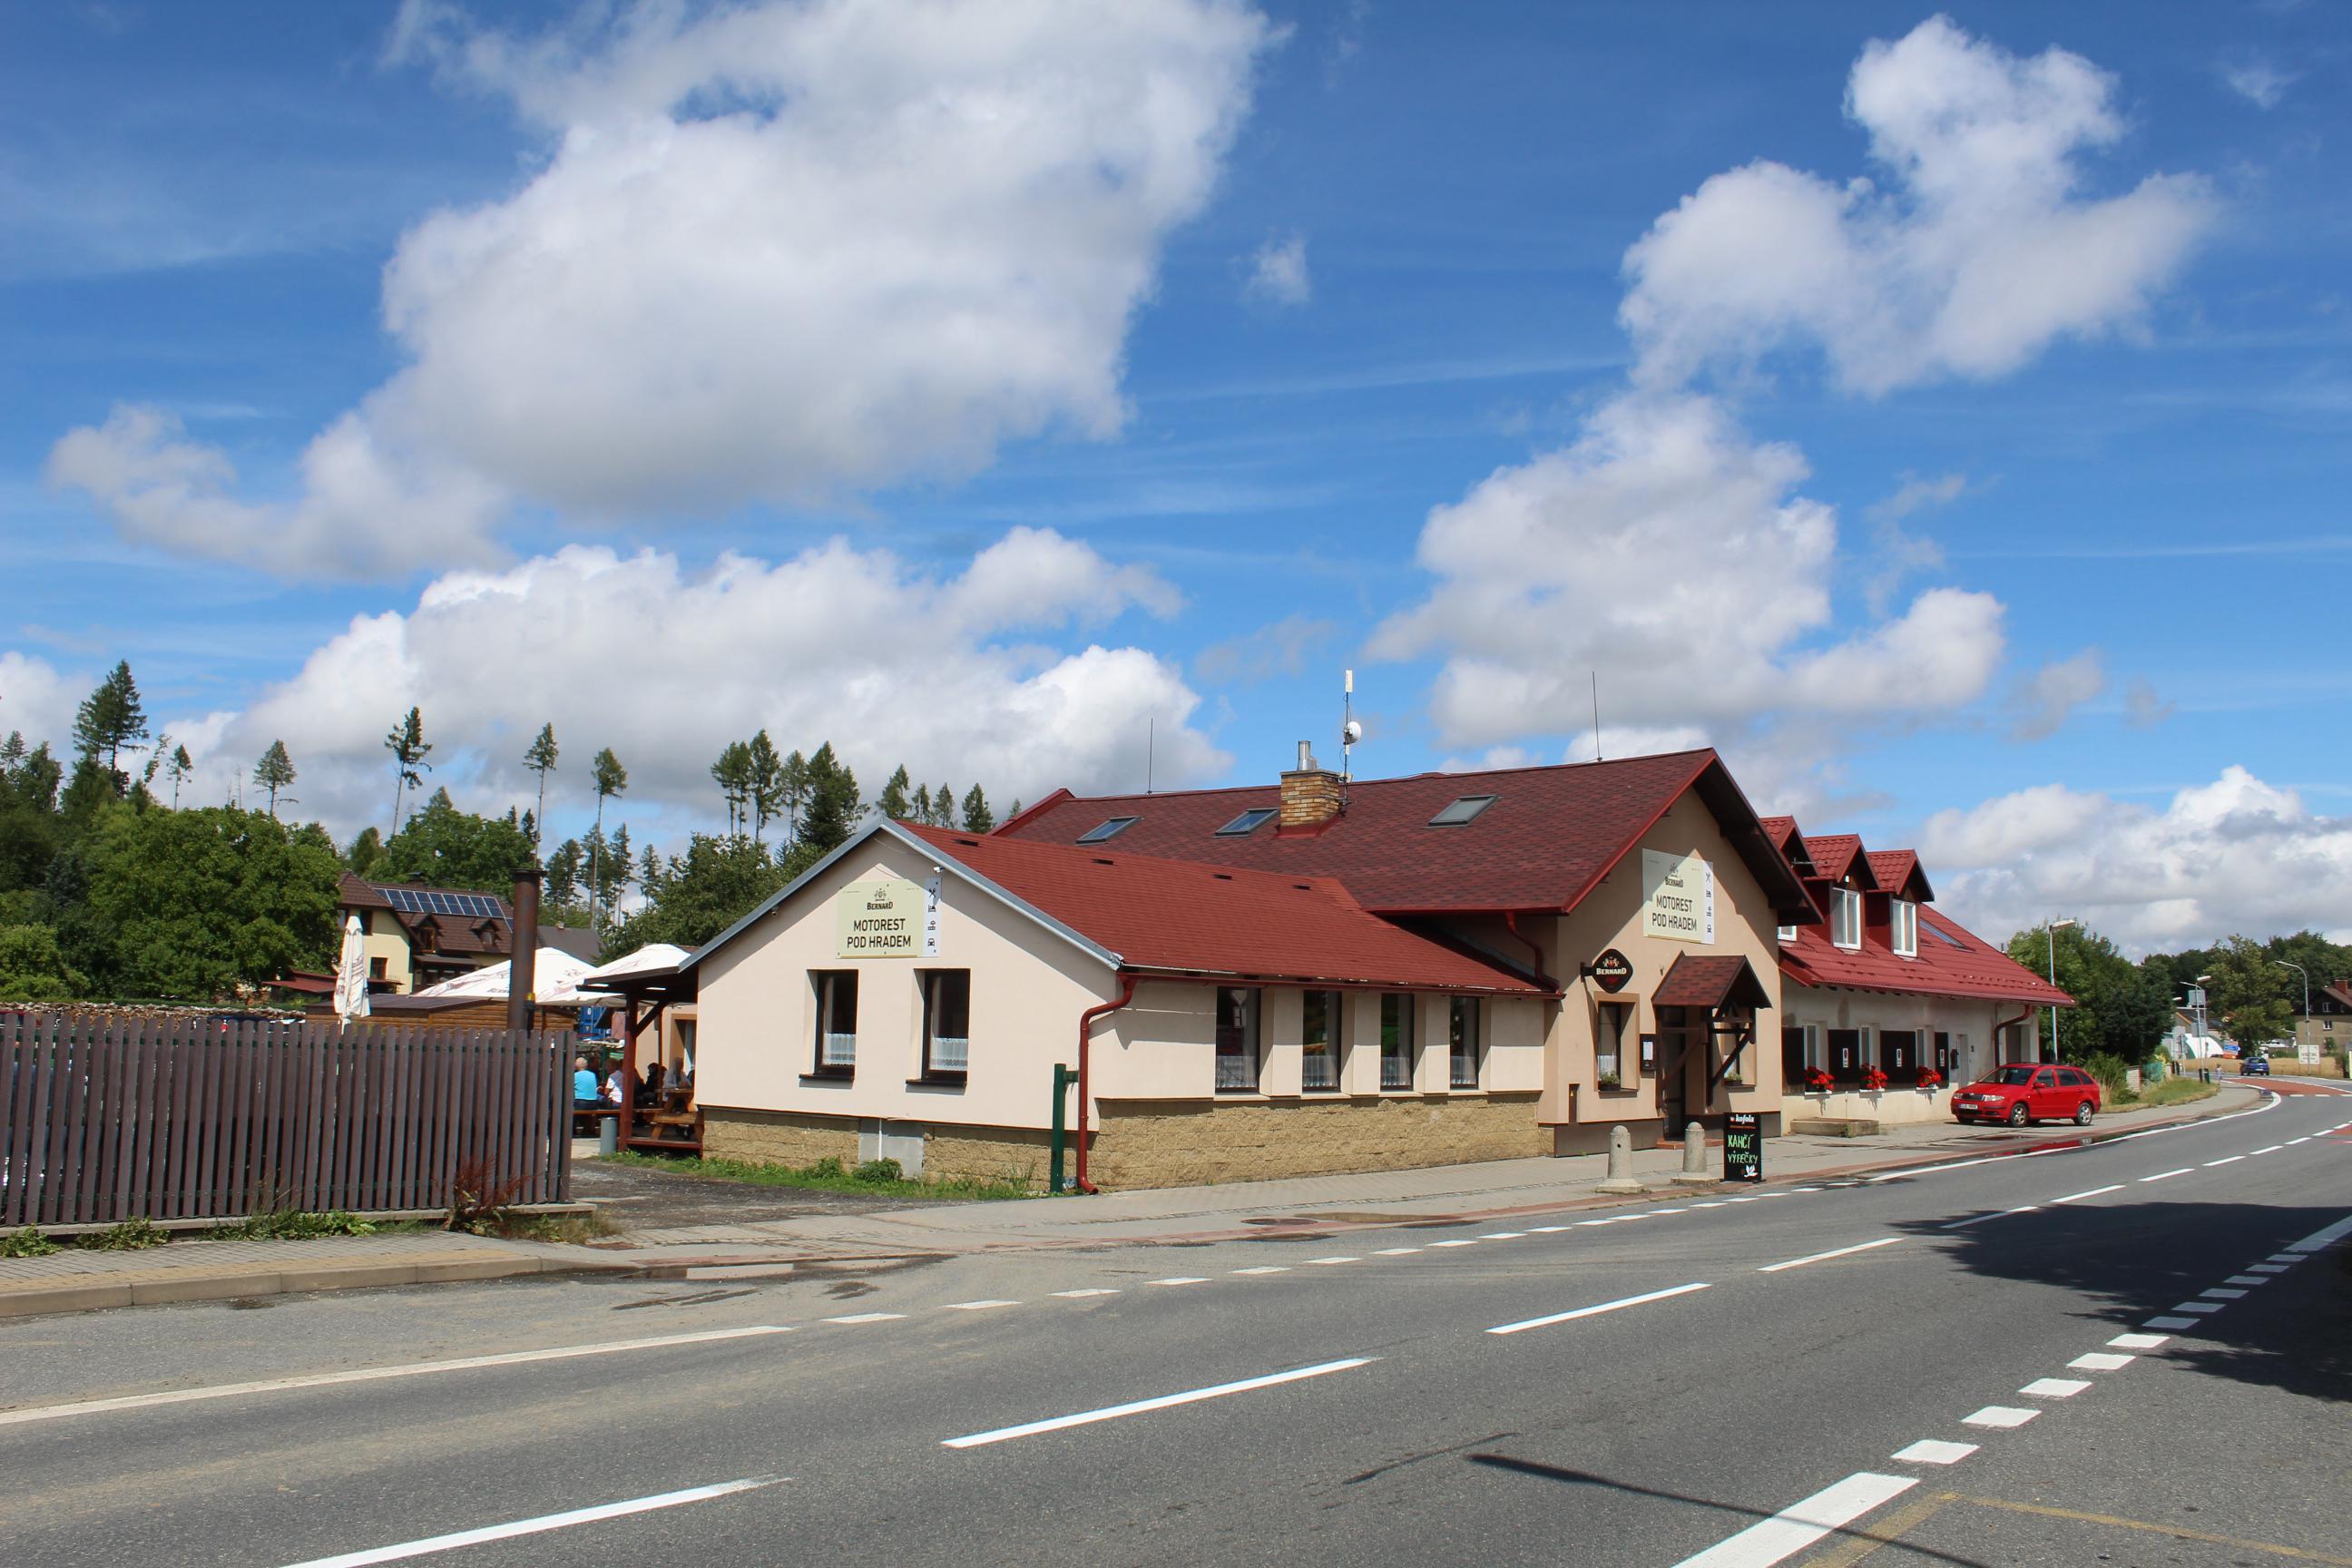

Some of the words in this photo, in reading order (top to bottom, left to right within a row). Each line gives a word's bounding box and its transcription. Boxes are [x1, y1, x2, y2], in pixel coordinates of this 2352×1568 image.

[867, 901, 894, 910] BERNARD
[1656, 895, 1692, 913] MOTOREST
[853, 918, 906, 932] MOTOREST
[1651, 913, 1667, 927] POD
[1668, 916, 1697, 931] HRADEM
[847, 936, 867, 948] POD
[868, 935, 911, 948] HRADEM
[1596, 967, 1627, 975] BERNARD
[1728, 1133, 1755, 1150] KANČÍ
